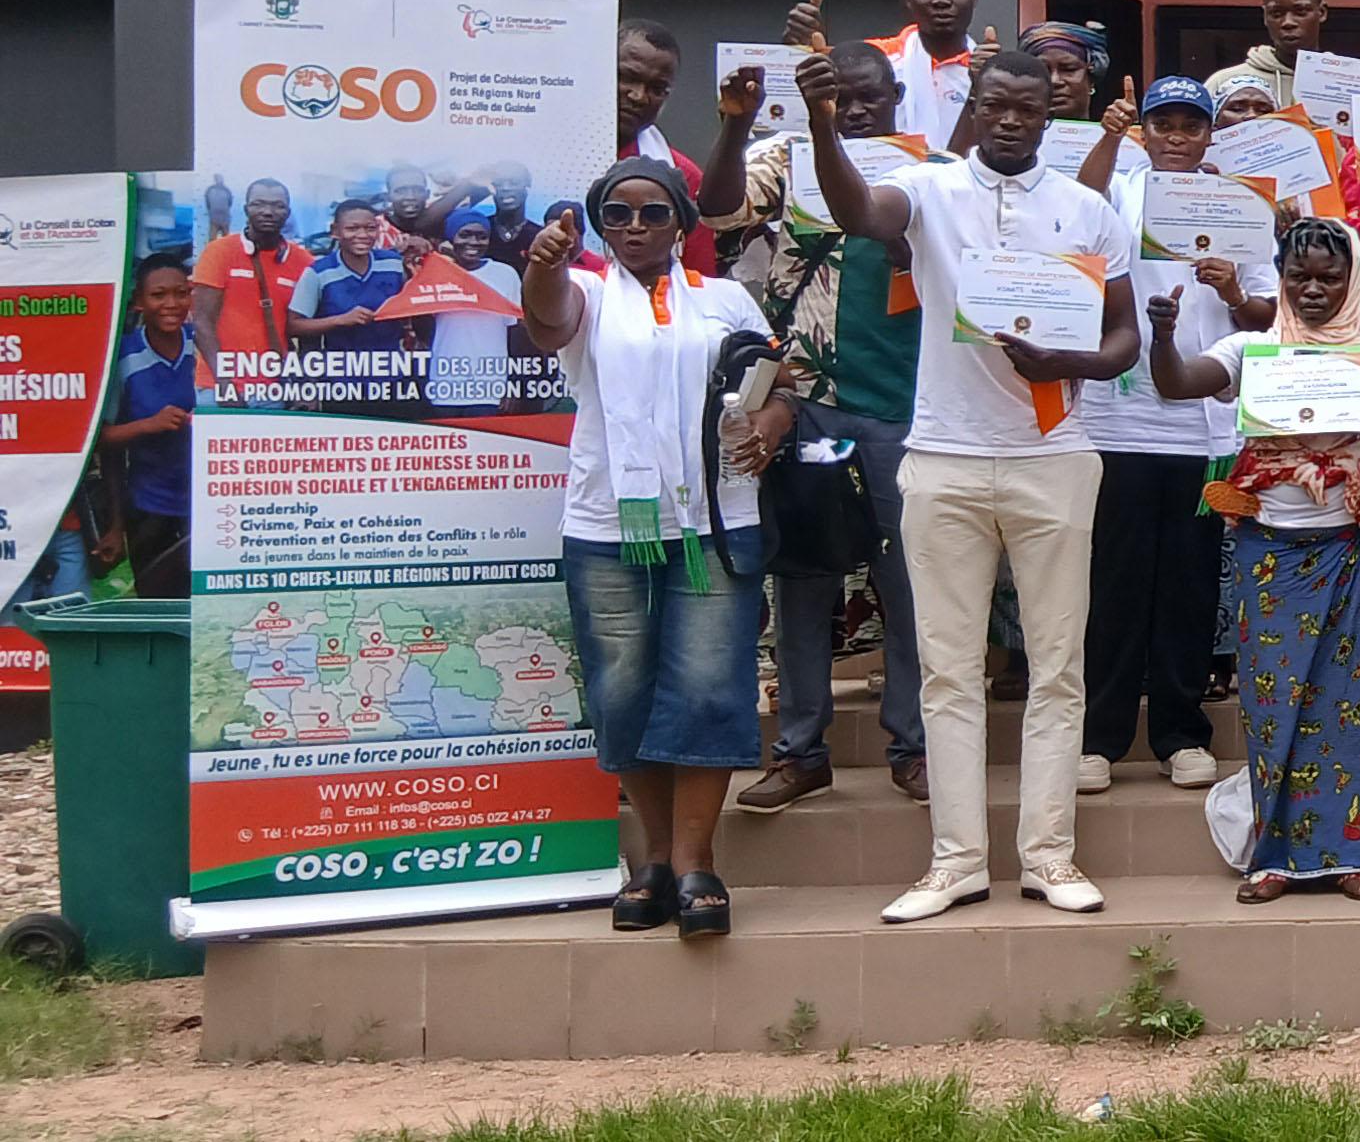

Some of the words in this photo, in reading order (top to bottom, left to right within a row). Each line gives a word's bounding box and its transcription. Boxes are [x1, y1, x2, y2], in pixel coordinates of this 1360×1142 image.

[449, 71, 477, 85] Projet
[480, 73, 491, 83] de
[494, 74, 538, 85] Cohésion
[540, 76, 575, 86] Sociale
[240, 63, 437, 122] COSO
[450, 87, 468, 96] des
[472, 87, 513, 99] Régions
[517, 89, 541, 99] Nord
[450, 101, 462, 110] du
[490, 102, 502, 111] de
[18, 294, 88, 317] Sociale
[216, 351, 431, 378] ENGAGEMENT
[438, 357, 470, 375] DES
[477, 357, 542, 376] JEUNES
[0, 368, 86, 401] HÉSION
[215, 383, 238, 402] LA
[244, 382, 362, 402] PROMOTION
[368, 382, 391, 401] DE
[396, 382, 420, 400] LA
[527, 380, 569, 399] SOCI
[208, 437, 338, 454] RENFORCEMENT
[343, 436, 374, 452] DES
[379, 433, 467, 451] CAPACITÉS
[208, 460, 239, 475] DES
[244, 458, 366, 475] GROUPEMENTS
[372, 457, 392, 472] DE
[395, 455, 472, 471] JEUNESSE
[477, 454, 509, 470] SUR
[513, 454, 531, 469] LA
[207, 477, 292, 497] COHÉSION
[297, 479, 365, 495] SOCIALE
[370, 478, 387, 493] ET
[391, 475, 510, 492] L'ENGAGEMENT
[514, 473, 568, 489] CITOYE
[240, 502, 319, 517] Leadership
[240, 518, 299, 532] Civisme,
[304, 517, 335, 529] Paix
[340, 517, 353, 528] et
[358, 514, 422, 528] Cohésion
[240, 533, 317, 547] Prévention
[322, 535, 335, 545] et
[340, 532, 393, 545] Gestion
[398, 530, 422, 542] des
[427, 528, 477, 541] Conflits
[490, 528, 500, 539] le
[240, 552, 260, 563] des
[265, 550, 303, 565] jeunes
[307, 549, 335, 562] dans
[340, 548, 350, 560] le
[354, 546, 404, 559] maintien
[408, 545, 423, 557] de
[427, 545, 439, 557] la
[442, 545, 469, 559] paix
[206, 574, 243, 590] DANS
[245, 573, 269, 589] LES
[272, 572, 287, 587] 10
[290, 569, 372, 587] CHEFS-LIEUX
[374, 567, 391, 583] DE
[393, 565, 449, 583] RÉGIONS
[452, 566, 471, 581] DU
[473, 564, 519, 580] PROJET
[521, 563, 556, 578] COSO
[207, 757, 261, 773] Jeune
[273, 753, 290, 768] tu
[295, 754, 313, 767] es
[317, 752, 350, 766] une
[353, 747, 397, 764] force
[400, 746, 443, 763] pour
[446, 743, 462, 758] la
[466, 737, 541, 757] cohésion
[318, 773, 499, 800] WWW.COSO.CI
[345, 805, 380, 817] Email
[275, 851, 368, 882] COSO
[392, 842, 471, 873] c'est
[475, 839, 523, 867] ZO
